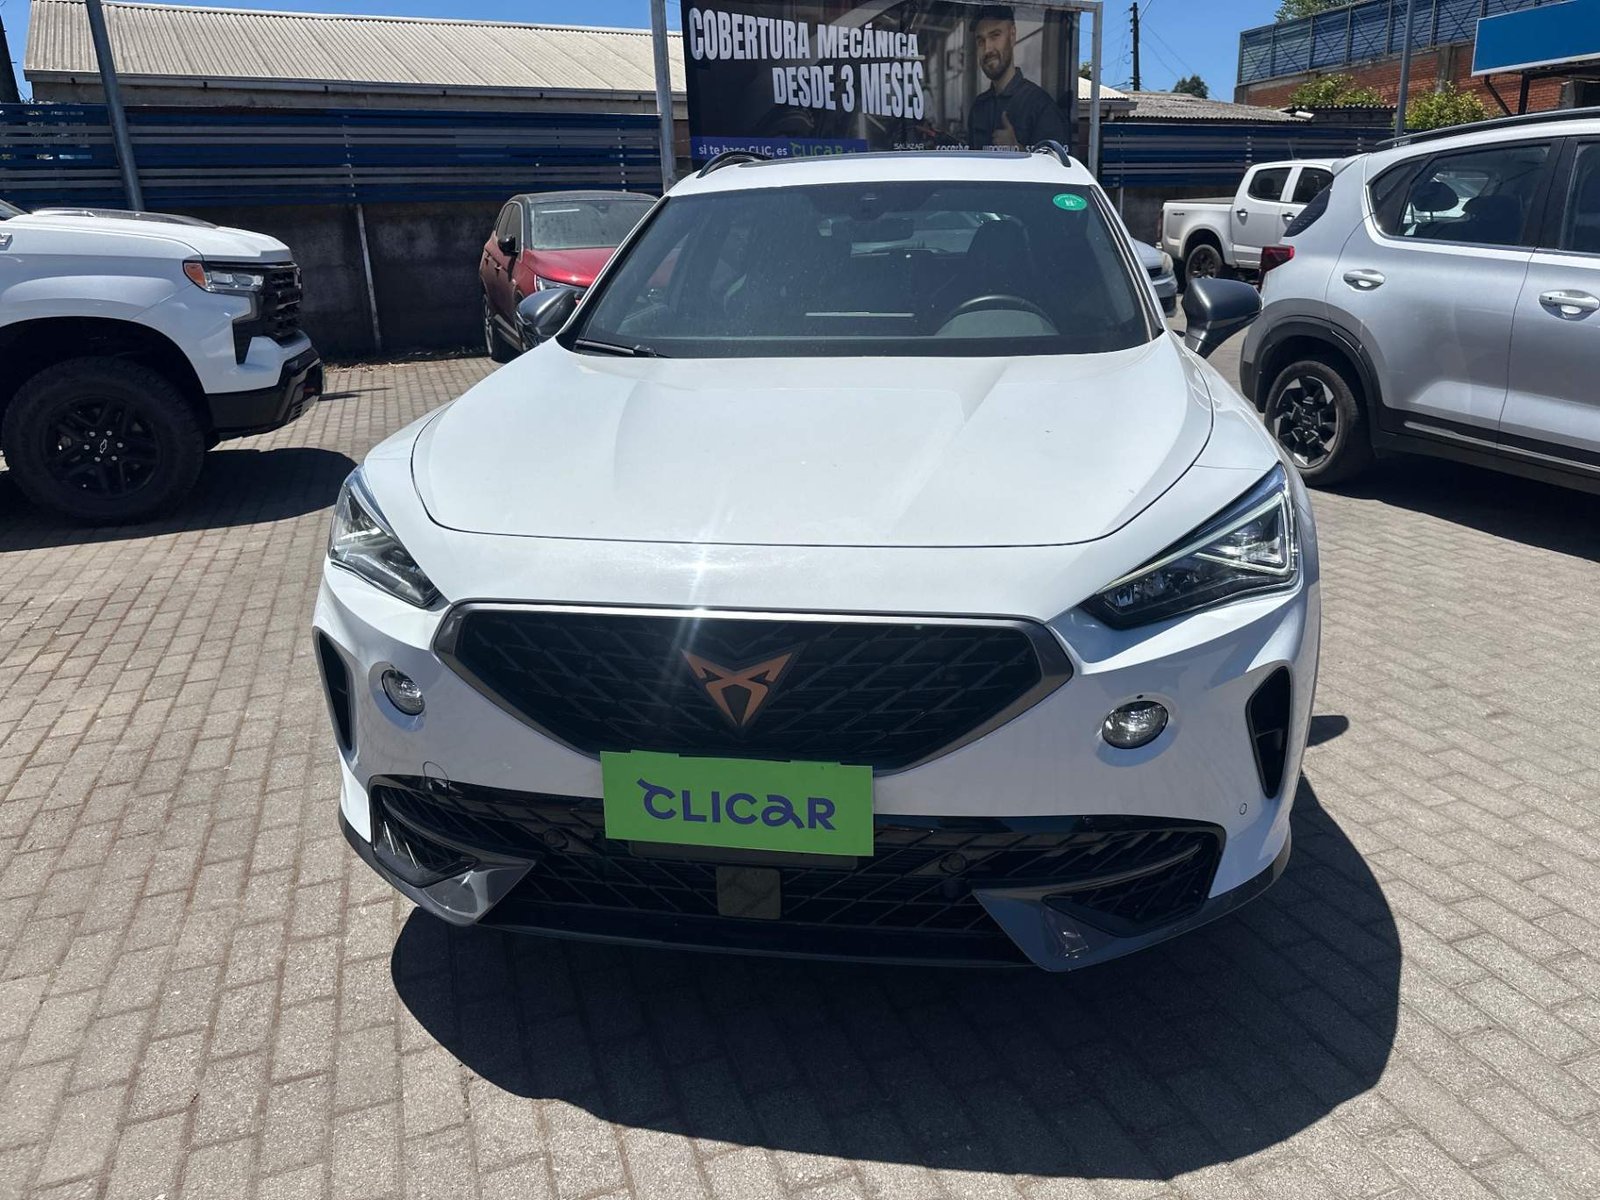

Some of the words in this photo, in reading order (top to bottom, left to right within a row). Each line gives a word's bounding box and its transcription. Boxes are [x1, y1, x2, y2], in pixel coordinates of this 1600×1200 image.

[689, 7, 811, 61] COBERTURA
[817, 22, 919, 59] MECÁNICA
[772, 65, 837, 112] DESDE
[841, 64, 856, 113] 3
[860, 60, 924, 121] MESES
[698, 144, 707, 155] si
[709, 145, 720, 155] te
[776, 146, 788, 156] es
